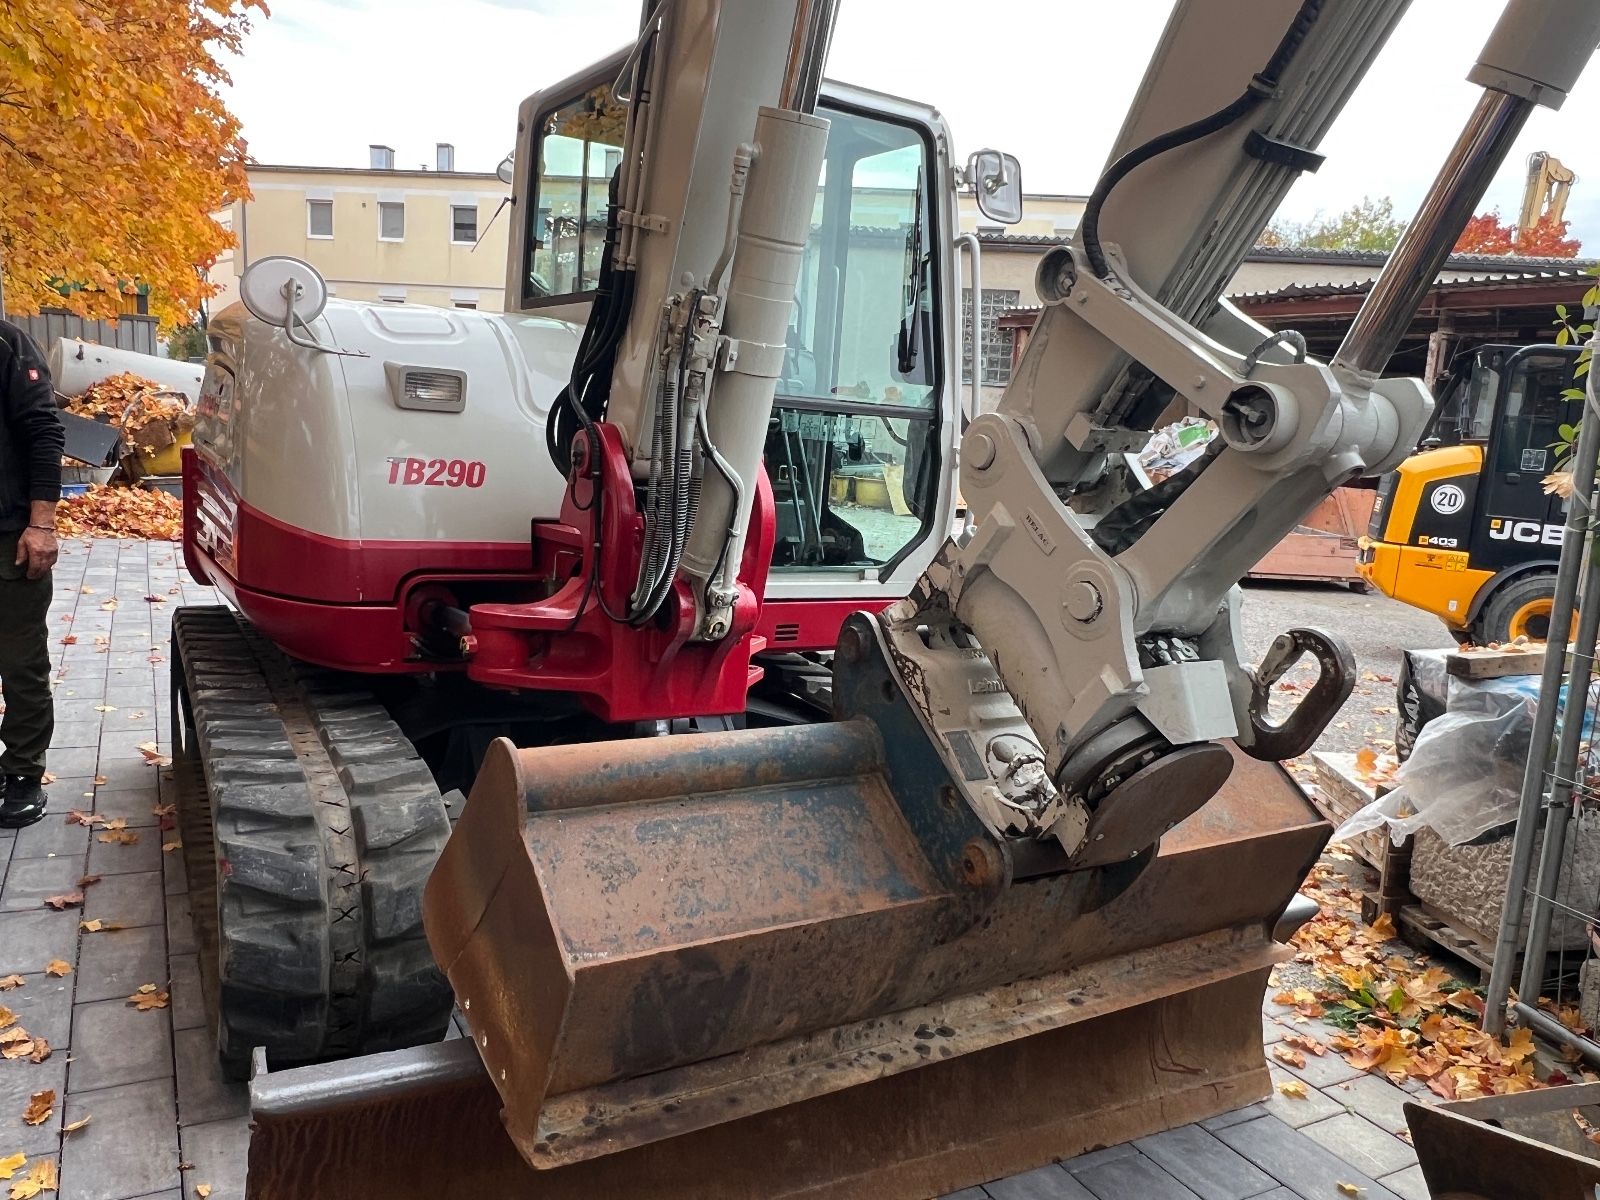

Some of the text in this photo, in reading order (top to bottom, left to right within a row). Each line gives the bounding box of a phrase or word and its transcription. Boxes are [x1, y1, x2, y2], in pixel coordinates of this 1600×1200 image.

[386, 456, 486, 488] TB290
[1437, 491, 1458, 507] 20
[1428, 536, 1458, 548] 403
